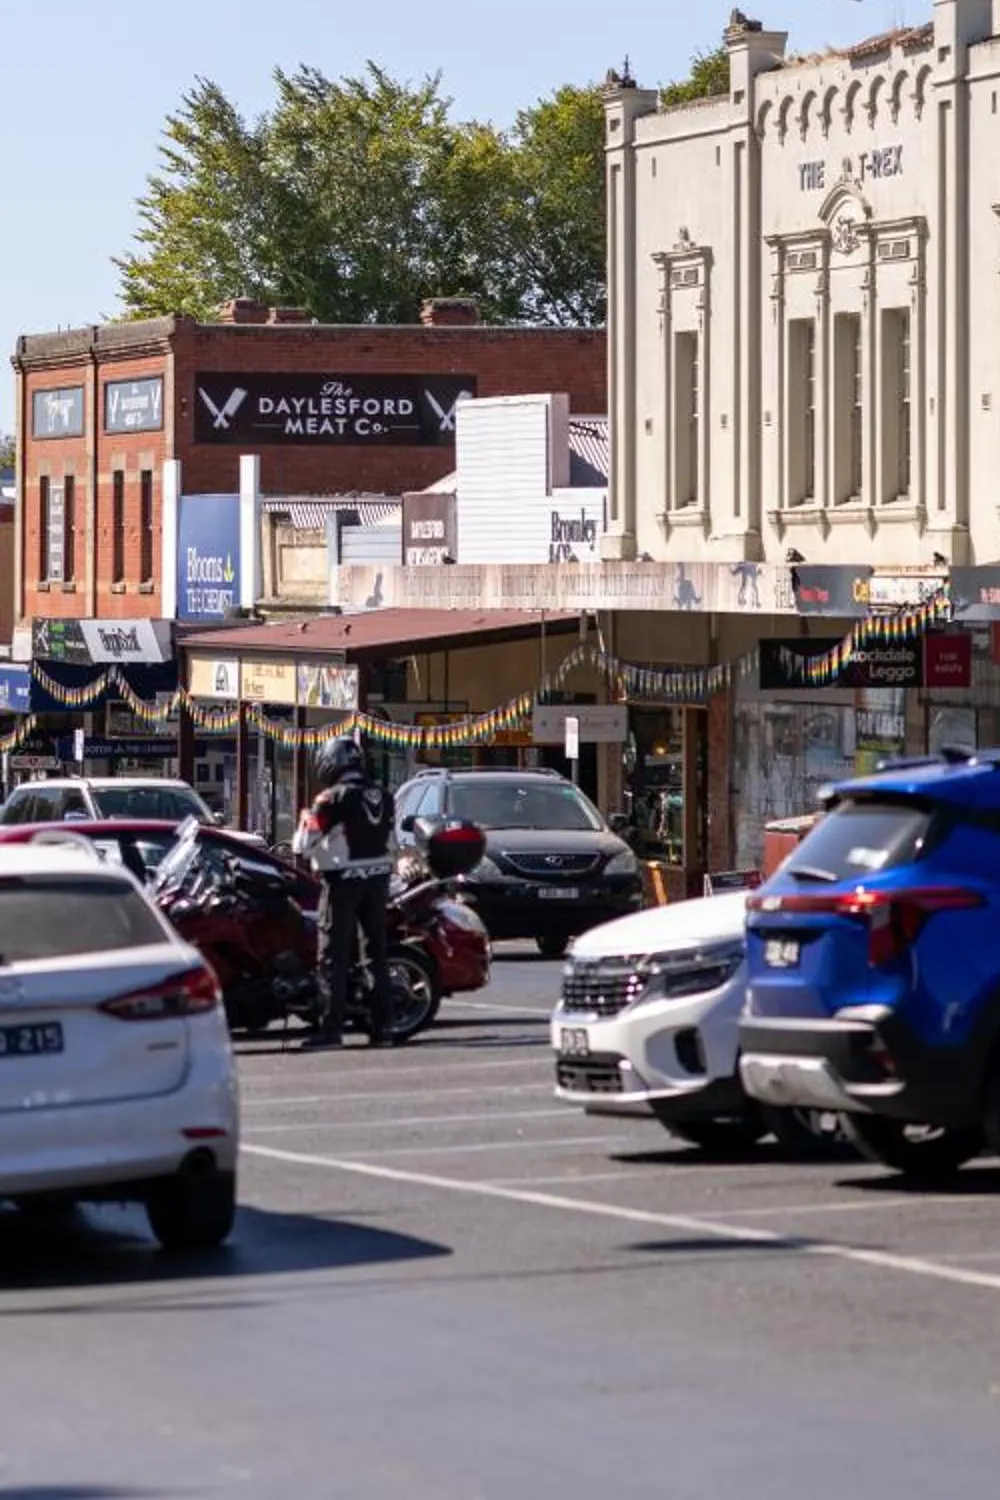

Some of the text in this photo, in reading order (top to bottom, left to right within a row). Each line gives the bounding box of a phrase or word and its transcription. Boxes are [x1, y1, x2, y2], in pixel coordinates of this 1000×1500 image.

[798, 160, 825, 191] THE
[319, 381, 353, 396] The
[258, 397, 414, 416] DAYLESFORD
[284, 417, 348, 436] MEAT
[551, 508, 598, 550] Bromley
[187, 547, 224, 582] Blooms
[869, 665, 915, 681] Leggo
